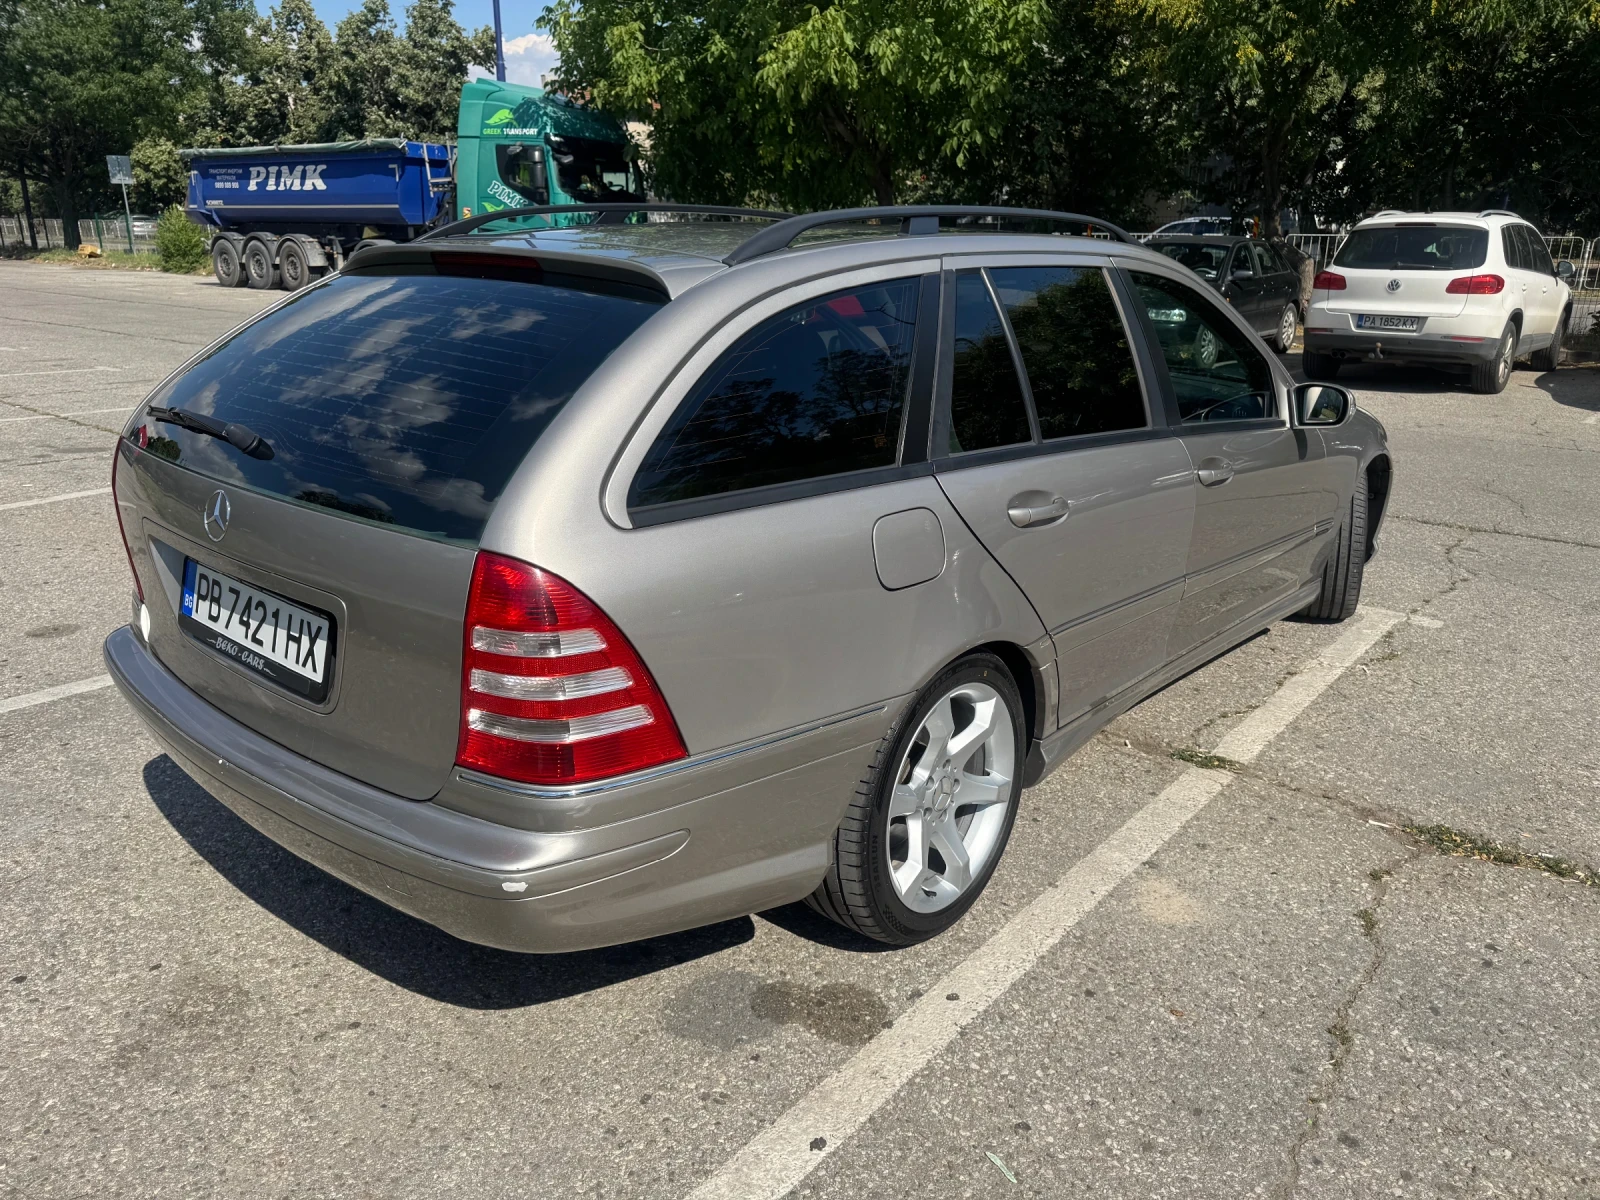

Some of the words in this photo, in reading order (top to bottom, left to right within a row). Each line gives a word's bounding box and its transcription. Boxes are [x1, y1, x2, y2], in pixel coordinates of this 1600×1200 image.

[503, 128, 538, 136] TRANSPORT
[247, 165, 327, 191] PIMK
[487, 180, 529, 208] PIMK
[184, 593, 193, 608] BG
